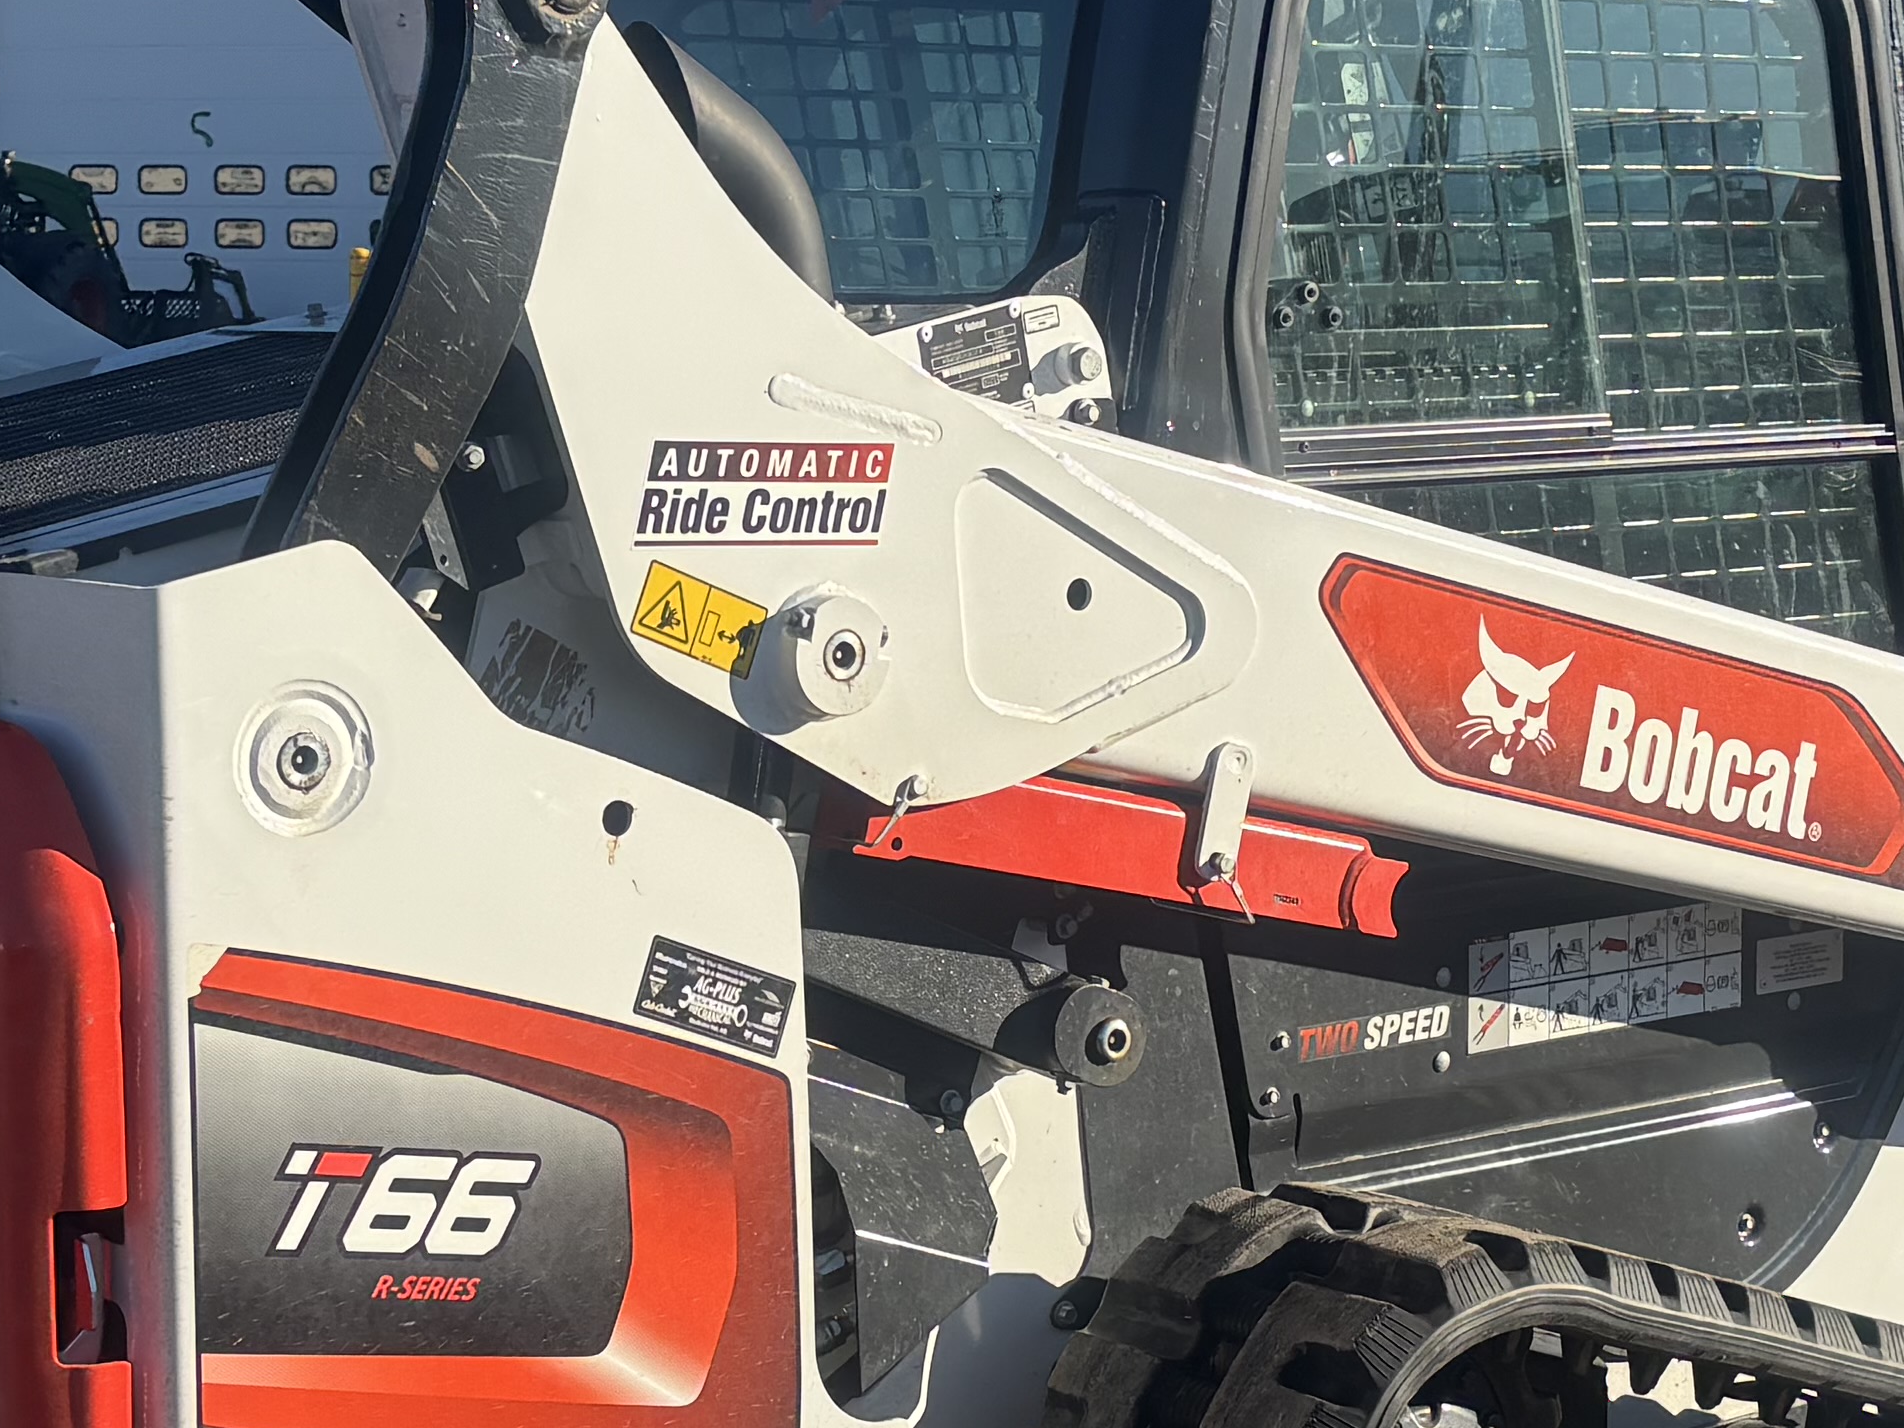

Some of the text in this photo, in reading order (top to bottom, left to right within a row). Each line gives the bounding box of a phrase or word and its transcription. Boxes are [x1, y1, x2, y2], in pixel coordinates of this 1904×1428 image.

[658, 447, 885, 478] AUTOMATIC
[636, 488, 887, 534] Ride Control
[1299, 1005, 1450, 1061] TWO SPEED
[272, 1146, 538, 1258] T66
[371, 1275, 481, 1302] R-SERIES
